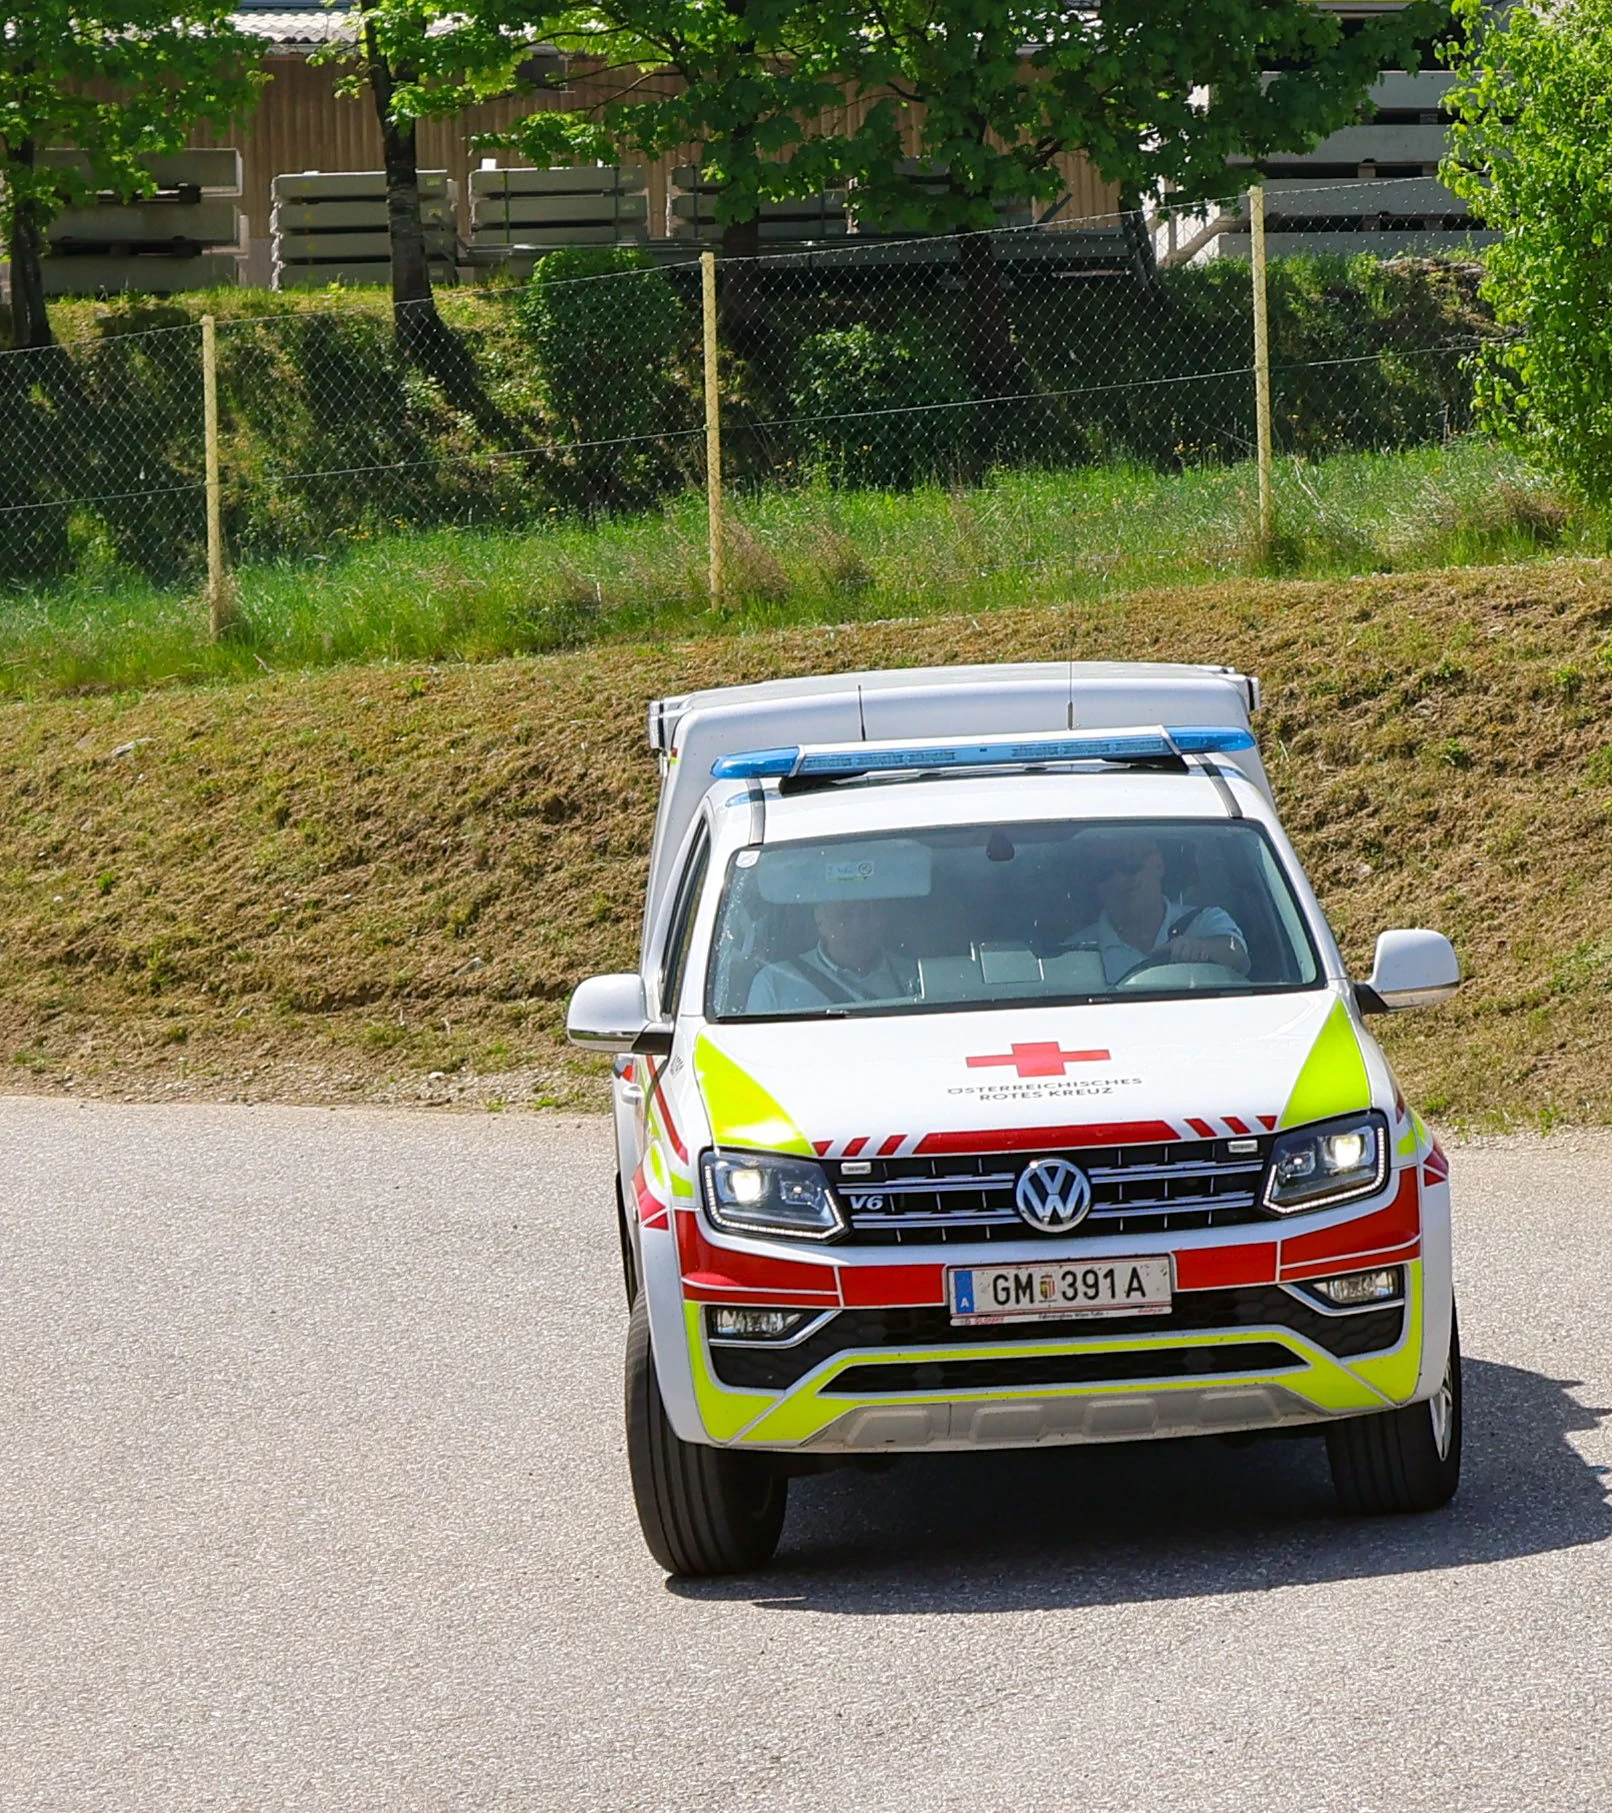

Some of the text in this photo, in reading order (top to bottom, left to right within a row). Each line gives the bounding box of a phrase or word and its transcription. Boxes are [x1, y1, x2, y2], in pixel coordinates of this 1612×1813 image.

[979, 1086, 1114, 1101] ROTES KREUZ
[850, 1195, 884, 1211] V6
[992, 1273, 1034, 1305] GM
[960, 1297, 969, 1308] A
